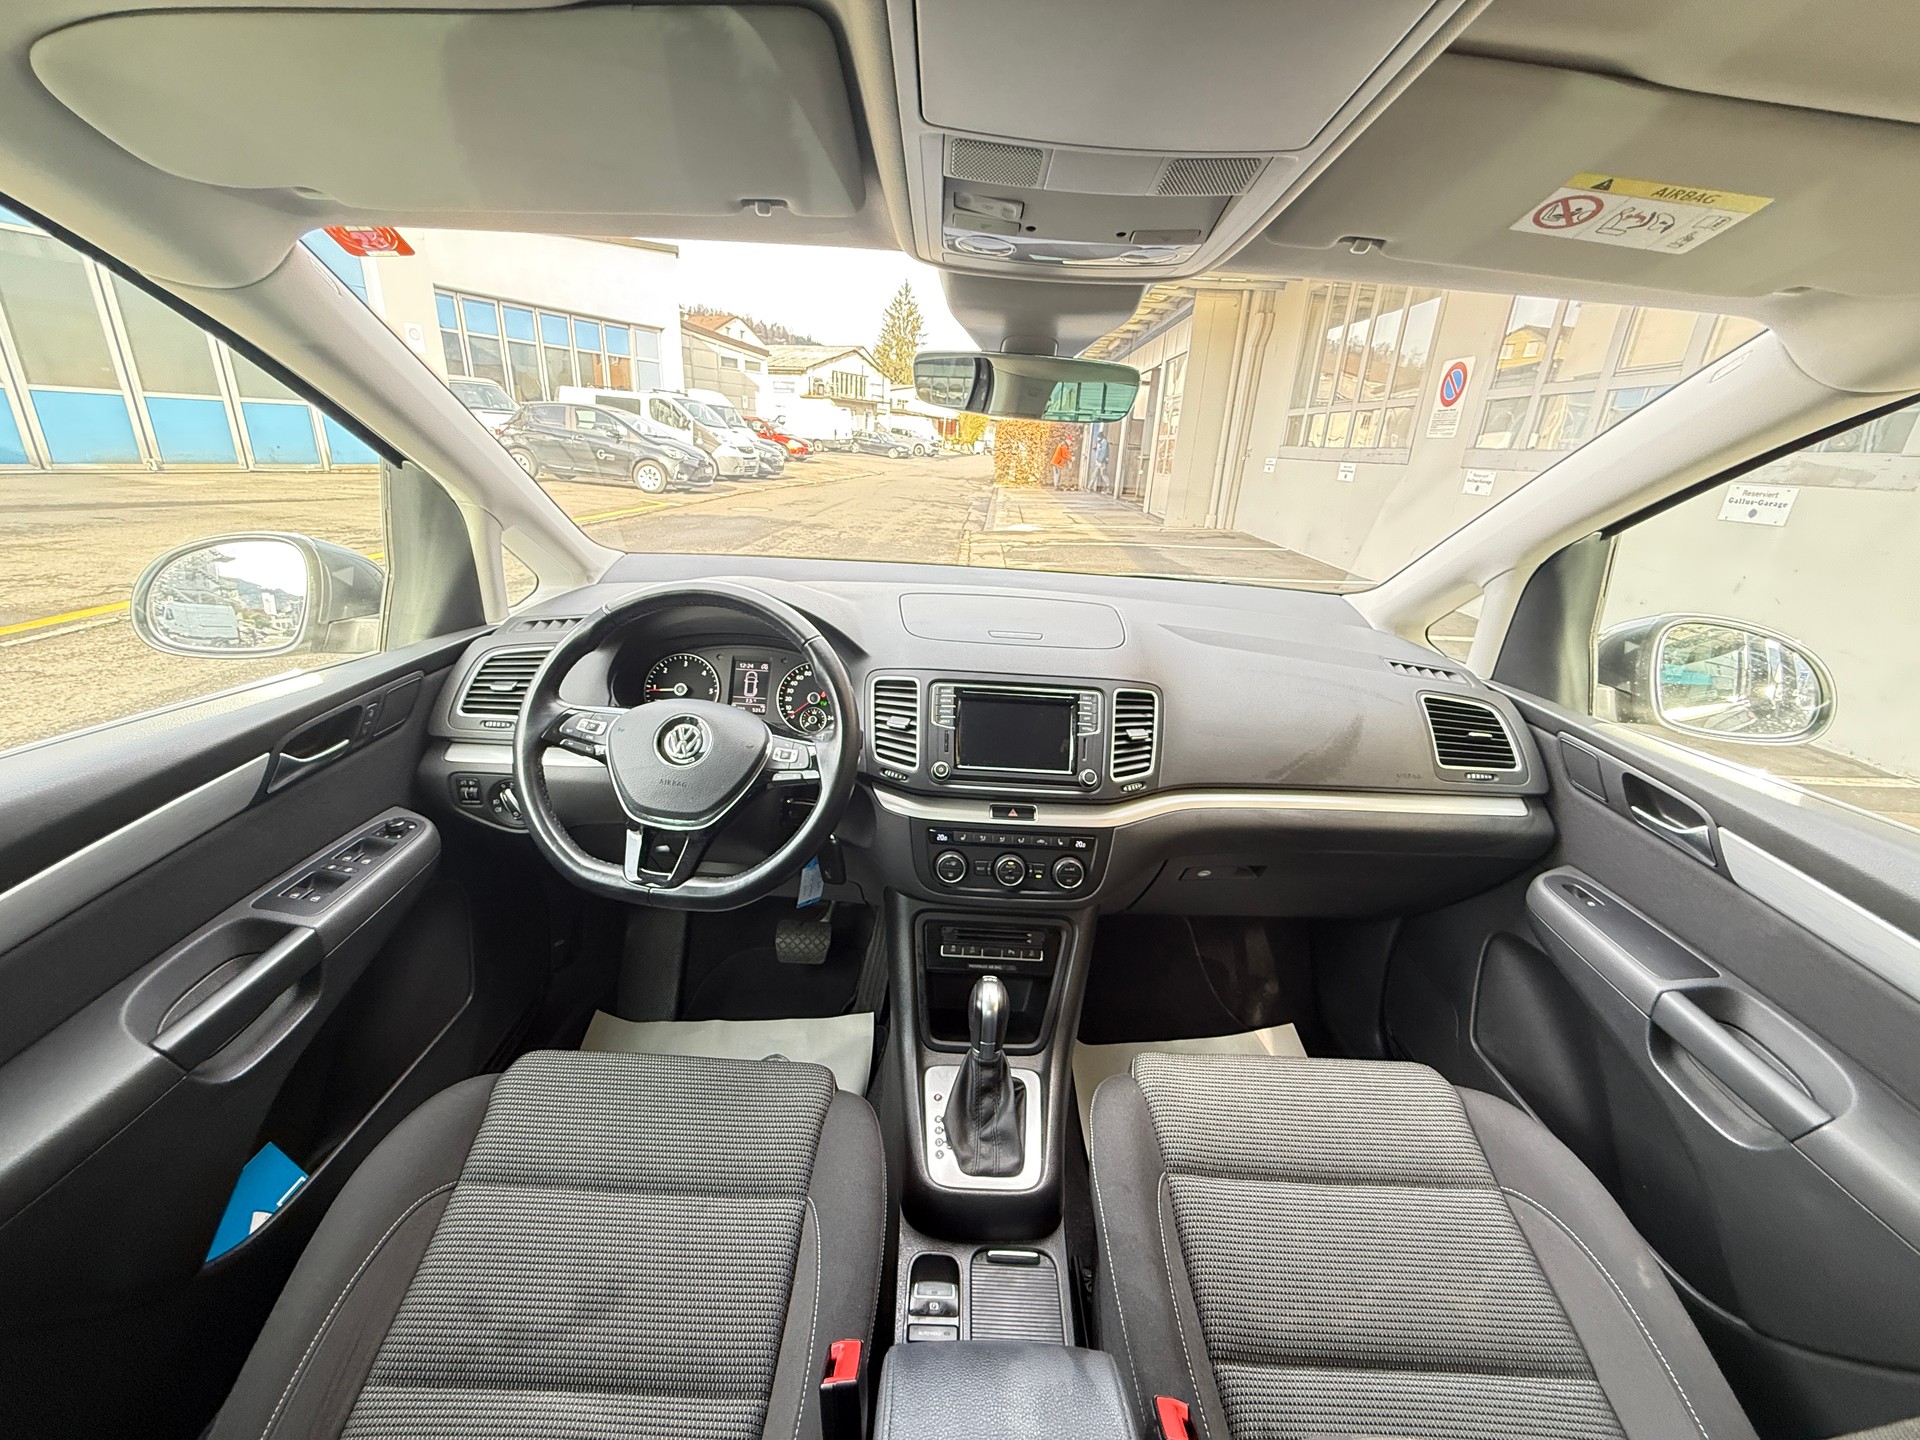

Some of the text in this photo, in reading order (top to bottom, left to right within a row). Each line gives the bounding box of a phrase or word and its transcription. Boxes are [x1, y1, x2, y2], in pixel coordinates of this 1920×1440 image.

[1650, 187, 1722, 204] AIRBAG
[1742, 489, 1779, 498] Reserviert
[1728, 497, 1788, 509] Gallus-Garage
